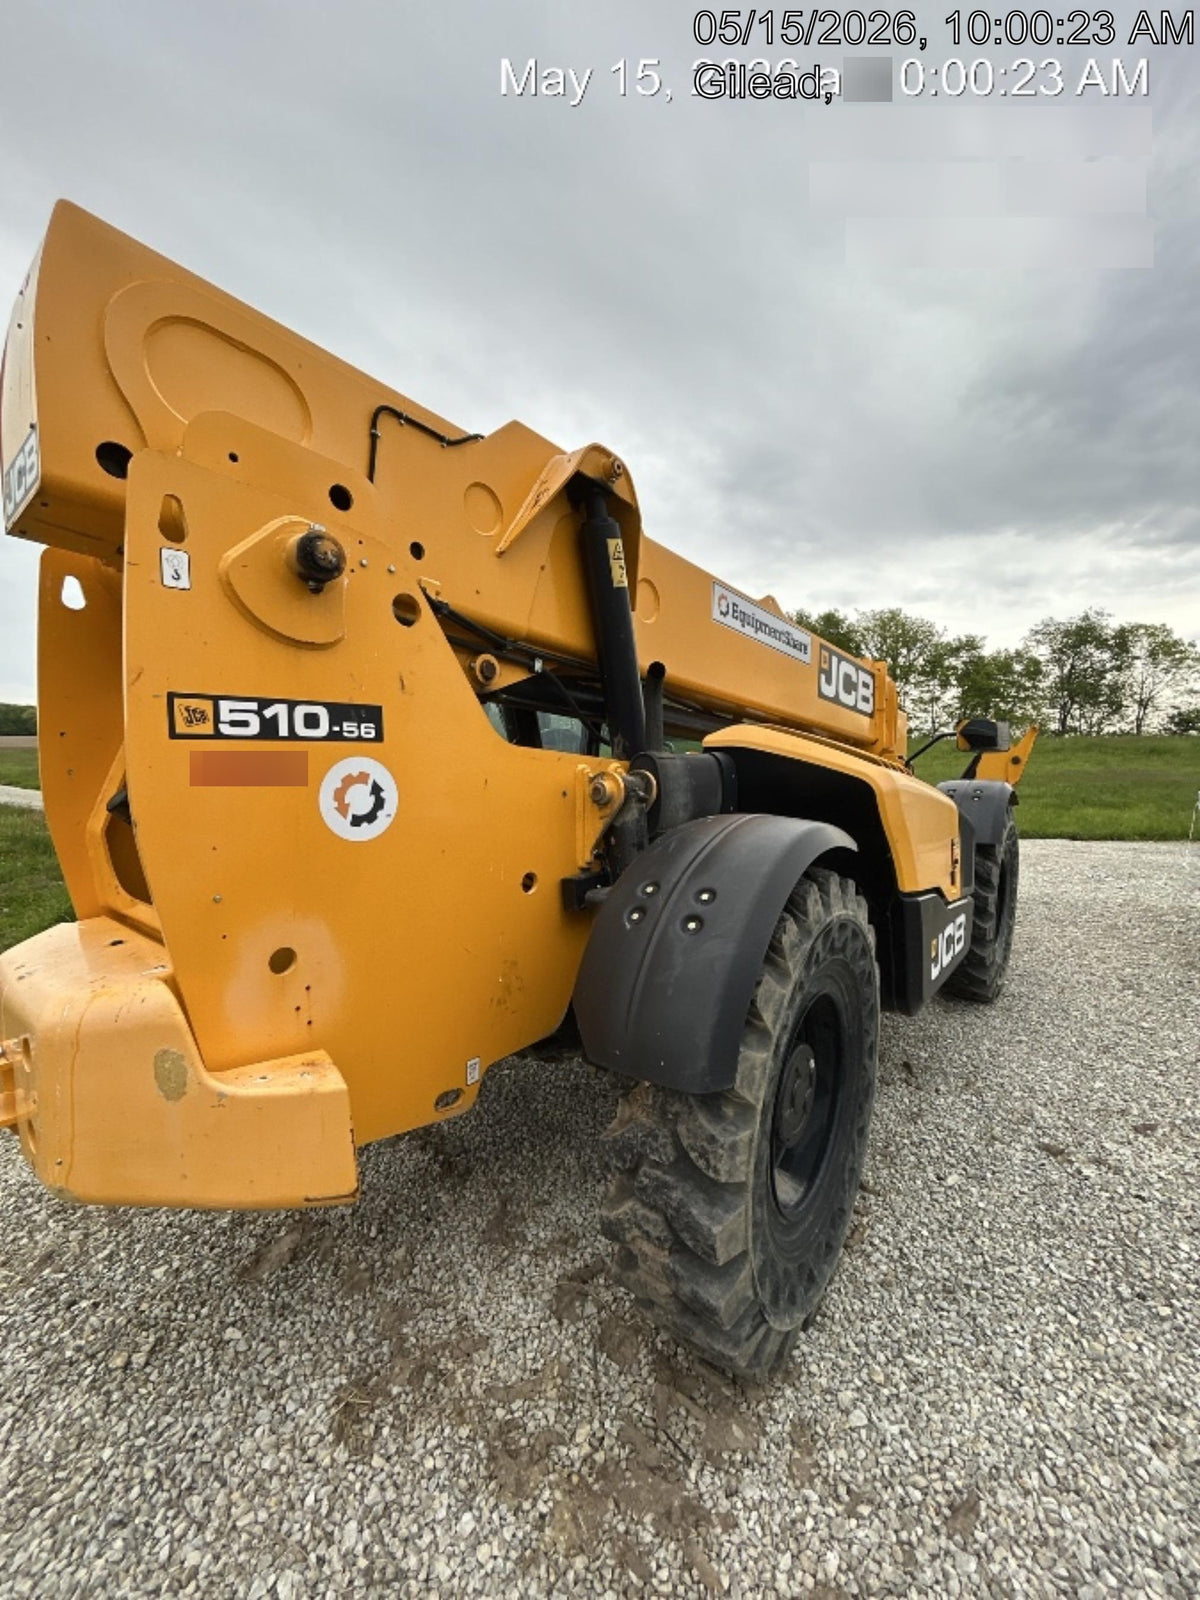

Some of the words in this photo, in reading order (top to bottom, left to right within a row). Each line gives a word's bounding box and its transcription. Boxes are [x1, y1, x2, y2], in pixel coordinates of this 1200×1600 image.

[731, 602, 809, 655] EquipmentShare
[819, 655, 875, 714] JCB
[217, 699, 377, 739] 510-56
[930, 912, 967, 981] JCB
